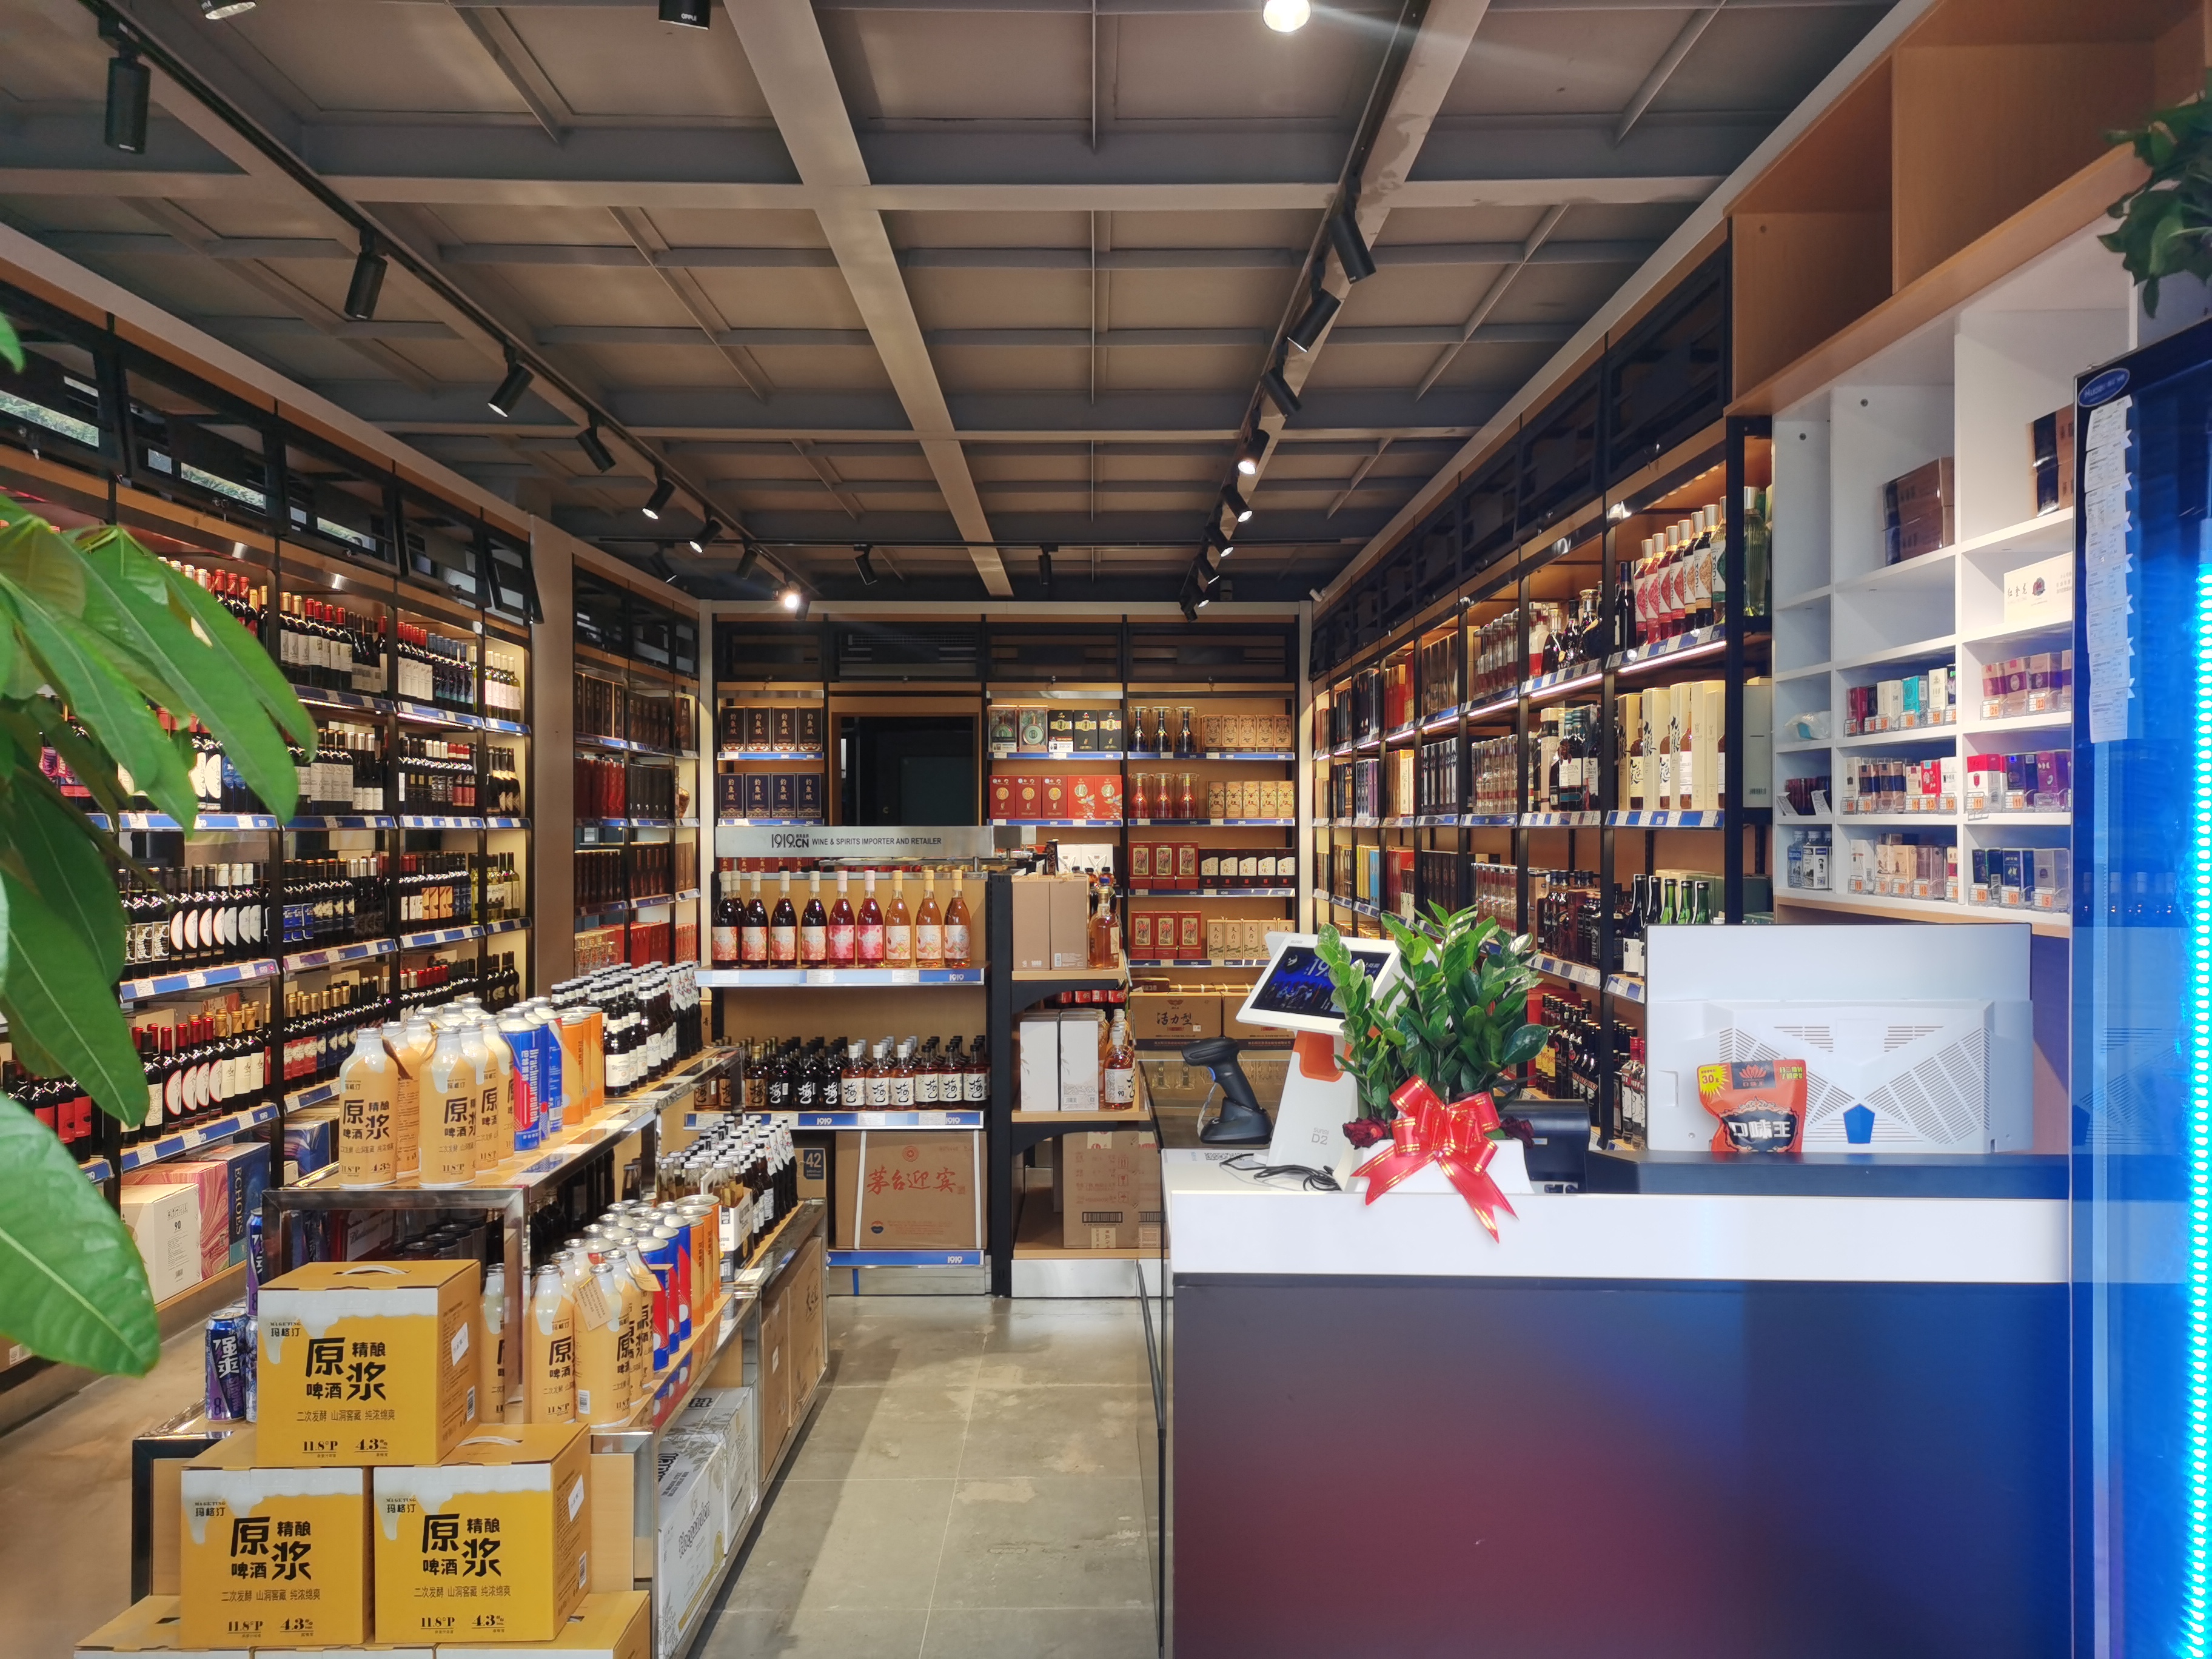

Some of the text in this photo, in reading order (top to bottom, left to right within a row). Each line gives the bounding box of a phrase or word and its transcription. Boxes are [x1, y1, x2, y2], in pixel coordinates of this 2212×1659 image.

[950, 973, 964, 982] 1919
[1156, 1011, 1193, 1026] 活力型
[343, 1099, 364, 1125] 原
[369, 1101, 390, 1112] 精酿
[444, 1097, 468, 1124] 原
[365, 1114, 390, 1141] 浆
[945, 1116, 961, 1125] 1919
[343, 1128, 363, 1140] 啤酒
[444, 1128, 467, 1138] 啤酒
[1728, 1119, 1791, 1139] 口味王
[1312, 1133, 1328, 1145] D2
[806, 1153, 822, 1167] 42
[866, 1165, 957, 1195] 茅台迎宾
[235, 1167, 243, 1235] ECHOES
[174, 1220, 181, 1231] 90
[947, 1255, 964, 1264] 1919
[270, 1327, 301, 1337] 玛格汀
[212, 1335, 240, 1379] 强爽
[306, 1337, 346, 1378] 原
[352, 1342, 386, 1358] 精酿
[549, 1336, 572, 1366] 原
[549, 1366, 572, 1379] 啤酒
[346, 1361, 386, 1401] 浆
[306, 1382, 342, 1400] 啤酒
[214, 1397, 221, 1416] 8
[297, 1410, 327, 1422] 二次发酵
[195, 1507, 226, 1517] 玛格汀
[387, 1504, 416, 1513] 玛格汀
[277, 1521, 312, 1537] 精酿
[422, 1513, 460, 1553] 原
[467, 1518, 500, 1534] 精酿
[230, 1516, 272, 1557] 原
[270, 1541, 312, 1581] 浆
[461, 1538, 501, 1577] 浆
[231, 1561, 267, 1580] 啤酒
[423, 1558, 458, 1576] 啤酒
[221, 1589, 253, 1602] 二次发酵
[414, 1586, 444, 1598] 二次发酵
